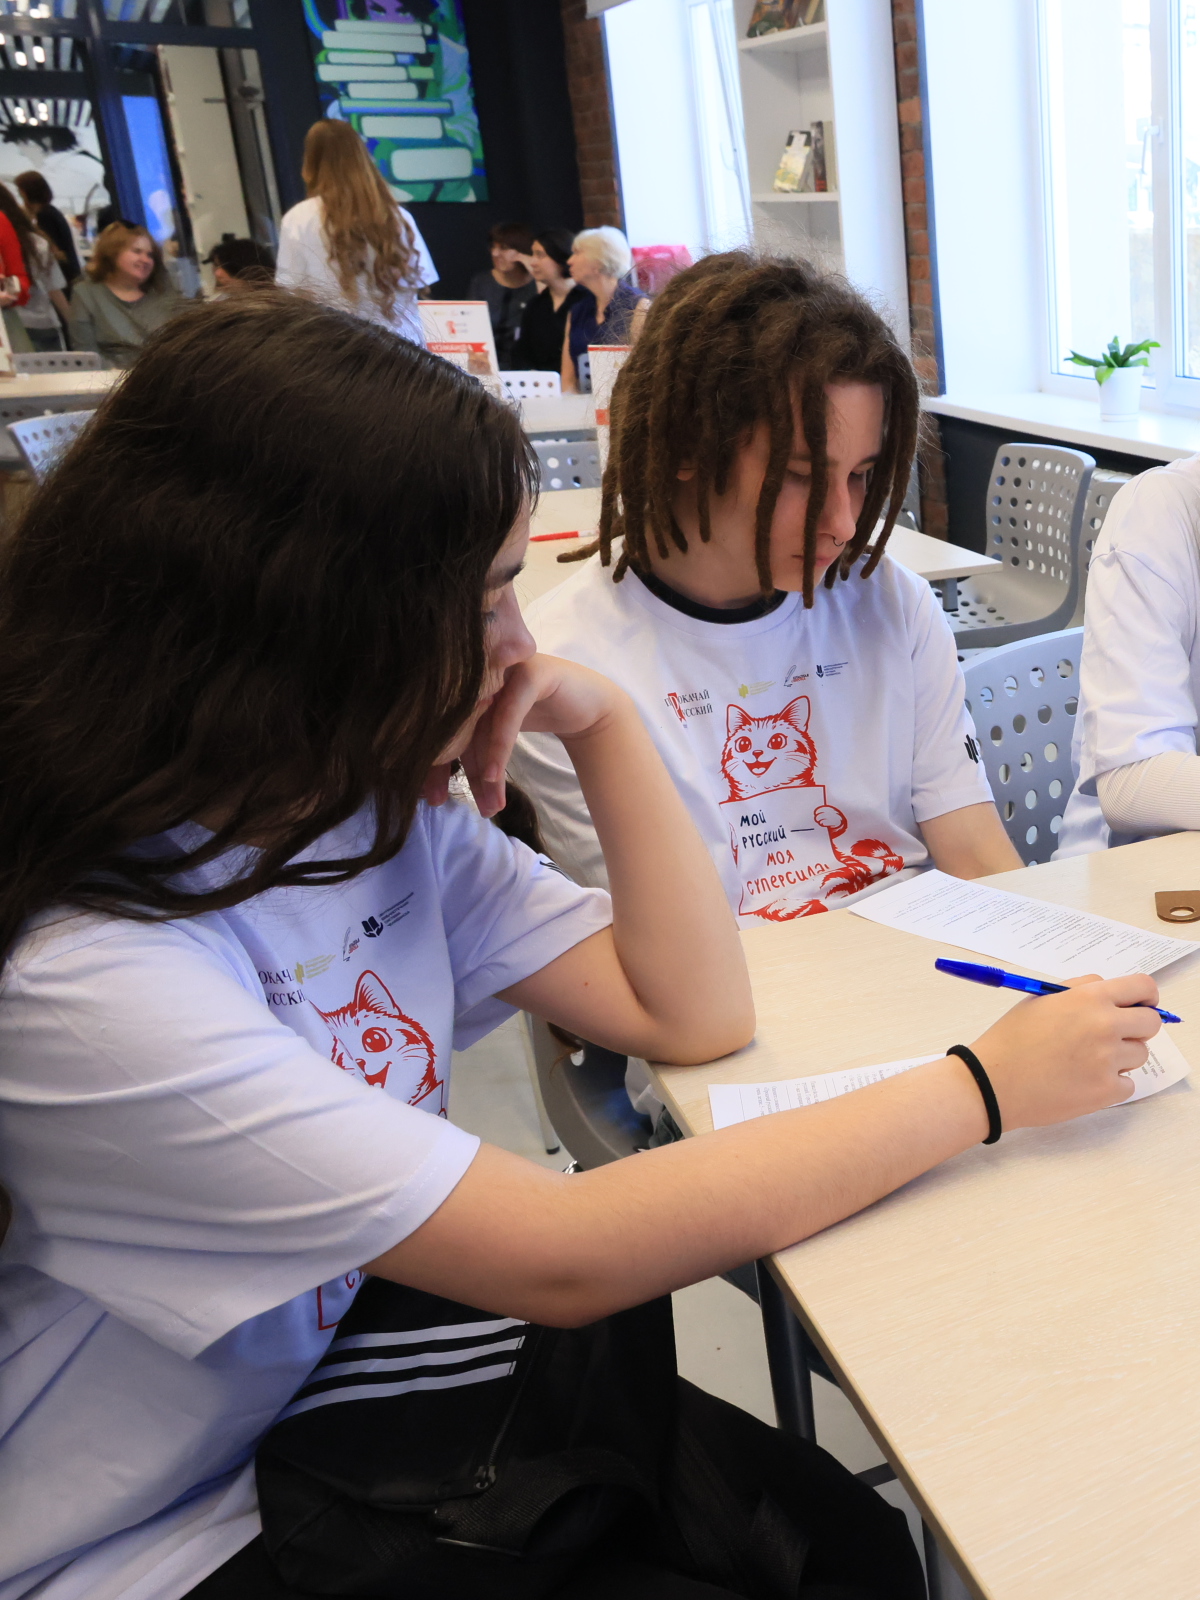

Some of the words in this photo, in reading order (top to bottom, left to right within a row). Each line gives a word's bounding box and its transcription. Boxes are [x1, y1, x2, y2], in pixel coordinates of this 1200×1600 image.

[740, 809, 767, 827] МОЙ
[742, 825, 787, 849] РУССКИЙ
[766, 849, 795, 866] МОЯ
